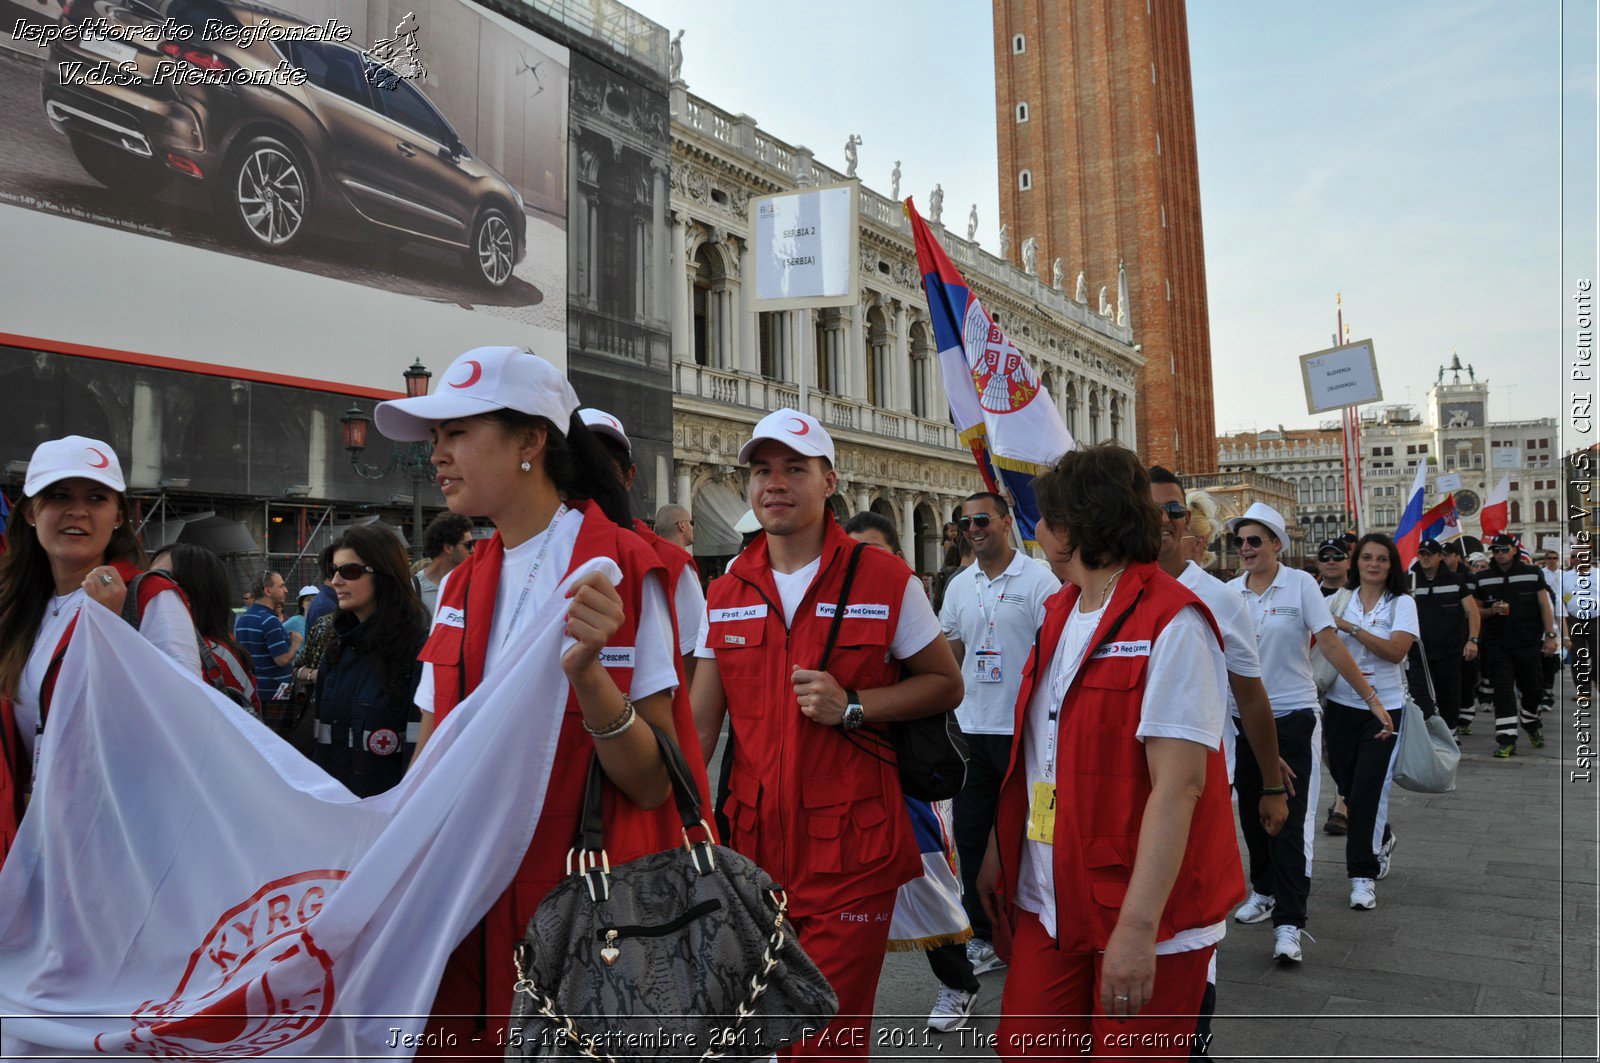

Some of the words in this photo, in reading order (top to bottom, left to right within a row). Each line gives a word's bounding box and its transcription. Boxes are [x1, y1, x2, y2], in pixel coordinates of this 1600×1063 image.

[20, 195, 35, 204] 149
[62, 204, 70, 213] La
[71, 206, 85, 218] foto
[121, 219, 138, 230] titolo
[783, 227, 810, 239] SERBIA
[811, 226, 816, 235] 2
[782, 256, 816, 268] (SERBIA)
[1327, 367, 1351, 376] SLOVENIA
[1327, 381, 1357, 392] (SLOVENIA)
[722, 611, 739, 619] First
[743, 609, 756, 617] Aid
[819, 606, 837, 616] Kyrg
[850, 607, 861, 616] Red
[861, 607, 887, 617] Crescent
[1120, 645, 1133, 653] Red
[840, 912, 868, 922] First
[208, 886, 325, 975] KYRG
